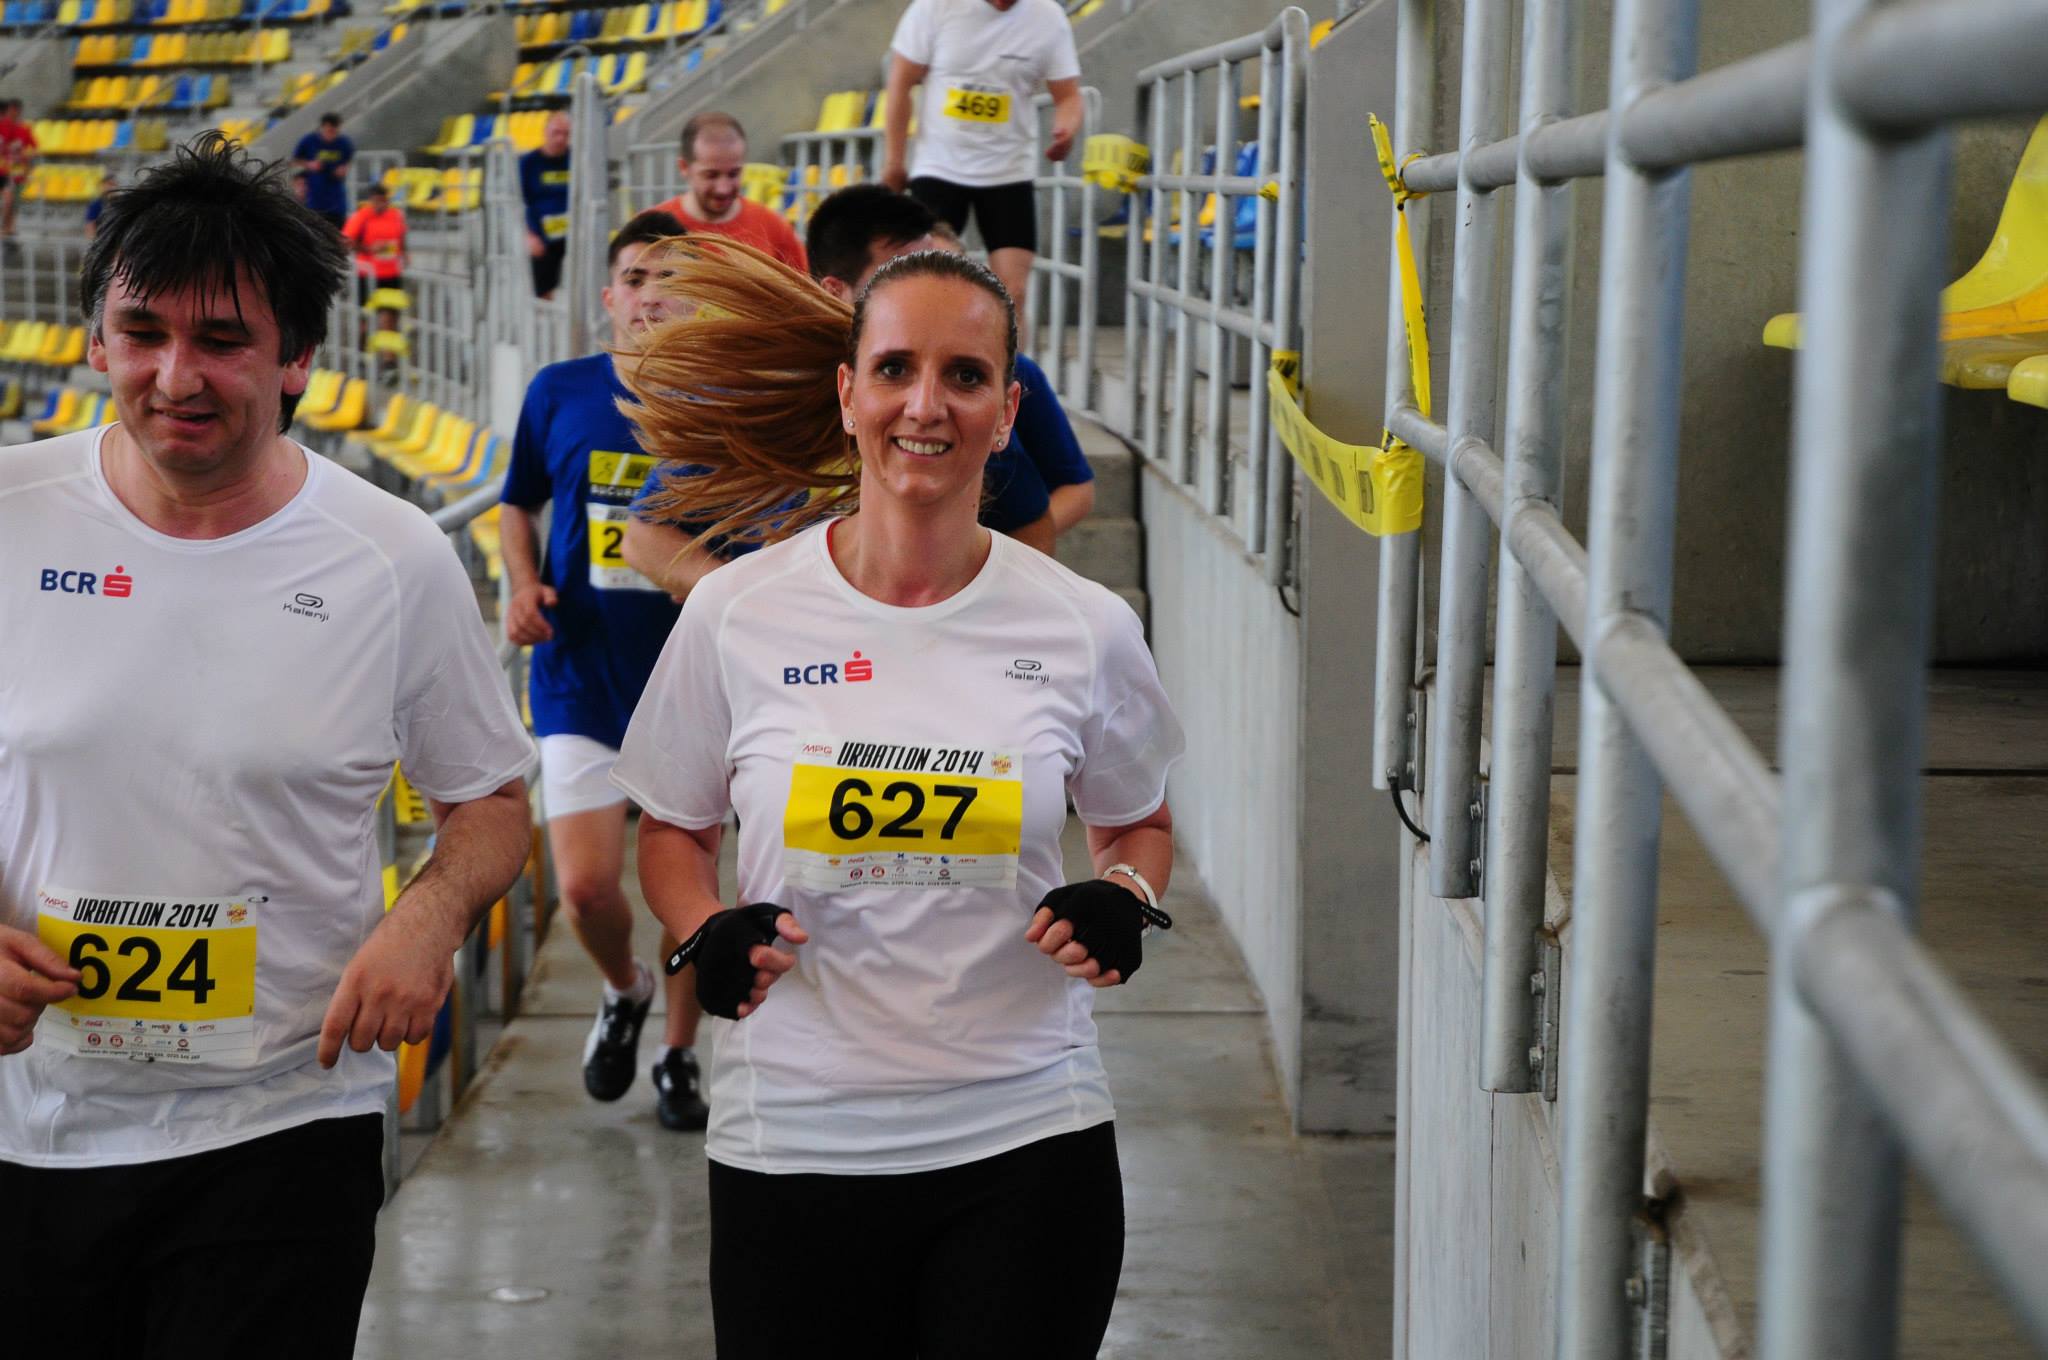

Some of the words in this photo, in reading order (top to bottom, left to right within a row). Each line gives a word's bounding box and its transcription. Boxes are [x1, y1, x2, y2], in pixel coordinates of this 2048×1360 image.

[955, 93, 1000, 117] 469
[40, 568, 97, 595] BCR
[282, 602, 330, 622] Kalenji
[783, 663, 838, 685] BCR
[1005, 670, 1050, 684] Kalenji
[837, 741, 932, 771] URBATLON
[930, 749, 985, 775] 2014
[828, 778, 978, 841] 627
[72, 897, 167, 928] URBATLON
[165, 903, 220, 928] 2014
[68, 933, 216, 1005] 624
